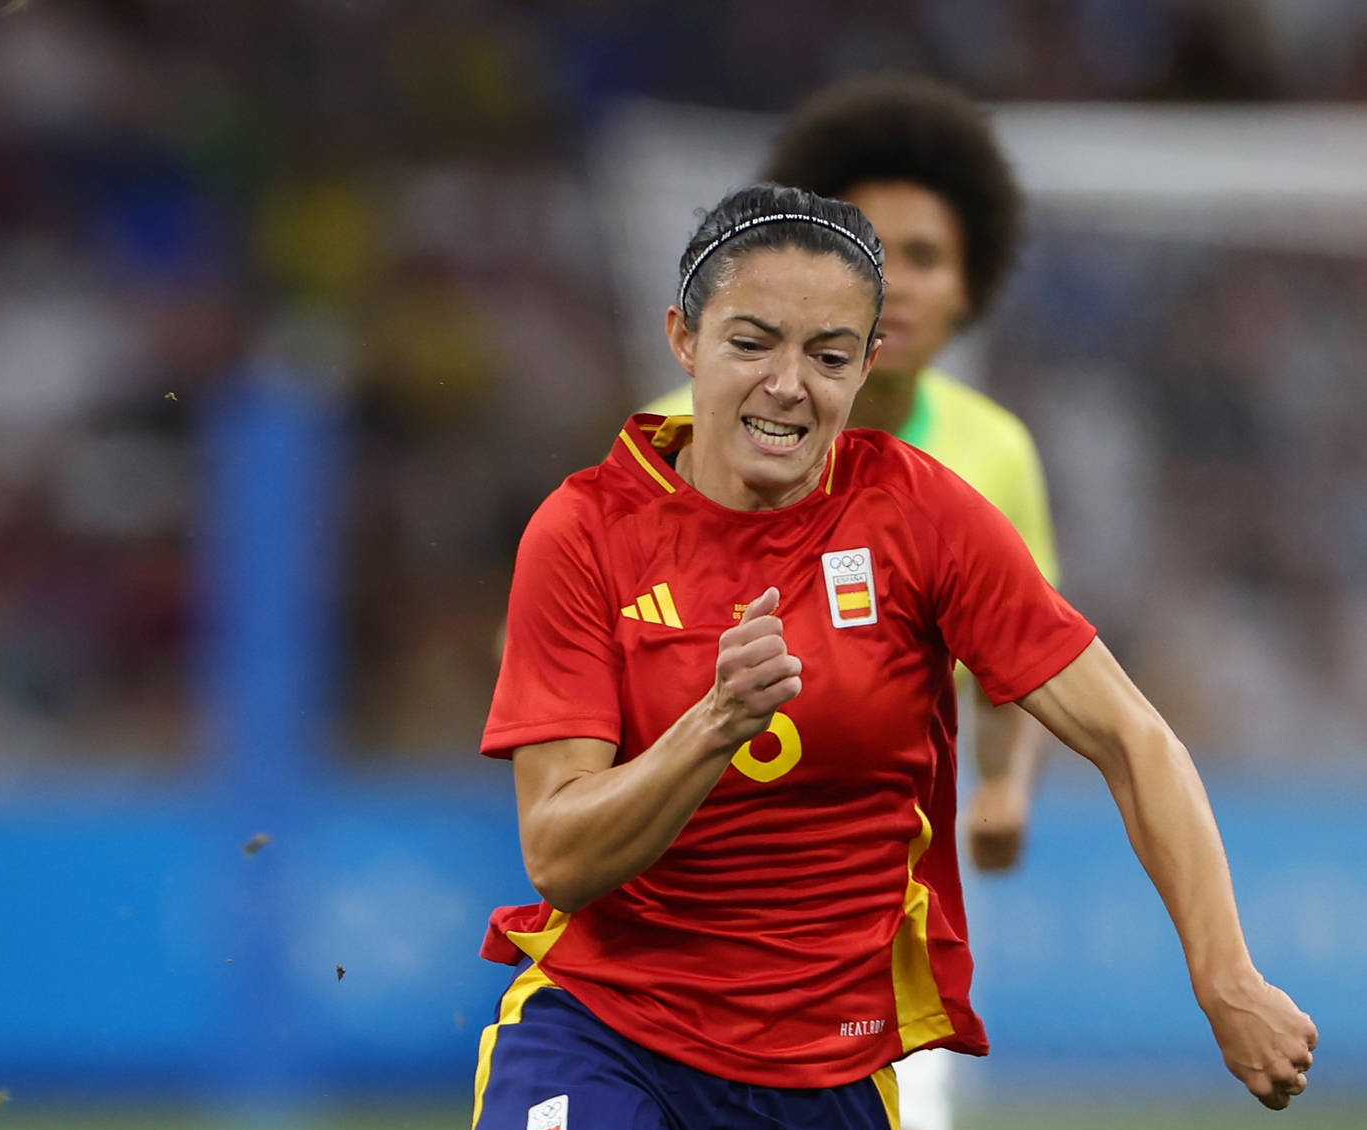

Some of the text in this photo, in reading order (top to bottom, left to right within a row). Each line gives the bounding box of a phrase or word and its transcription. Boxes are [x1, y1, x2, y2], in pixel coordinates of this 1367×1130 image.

[734, 220, 751, 232] THE
[752, 213, 784, 225] BRAND
[811, 216, 830, 226] THE
